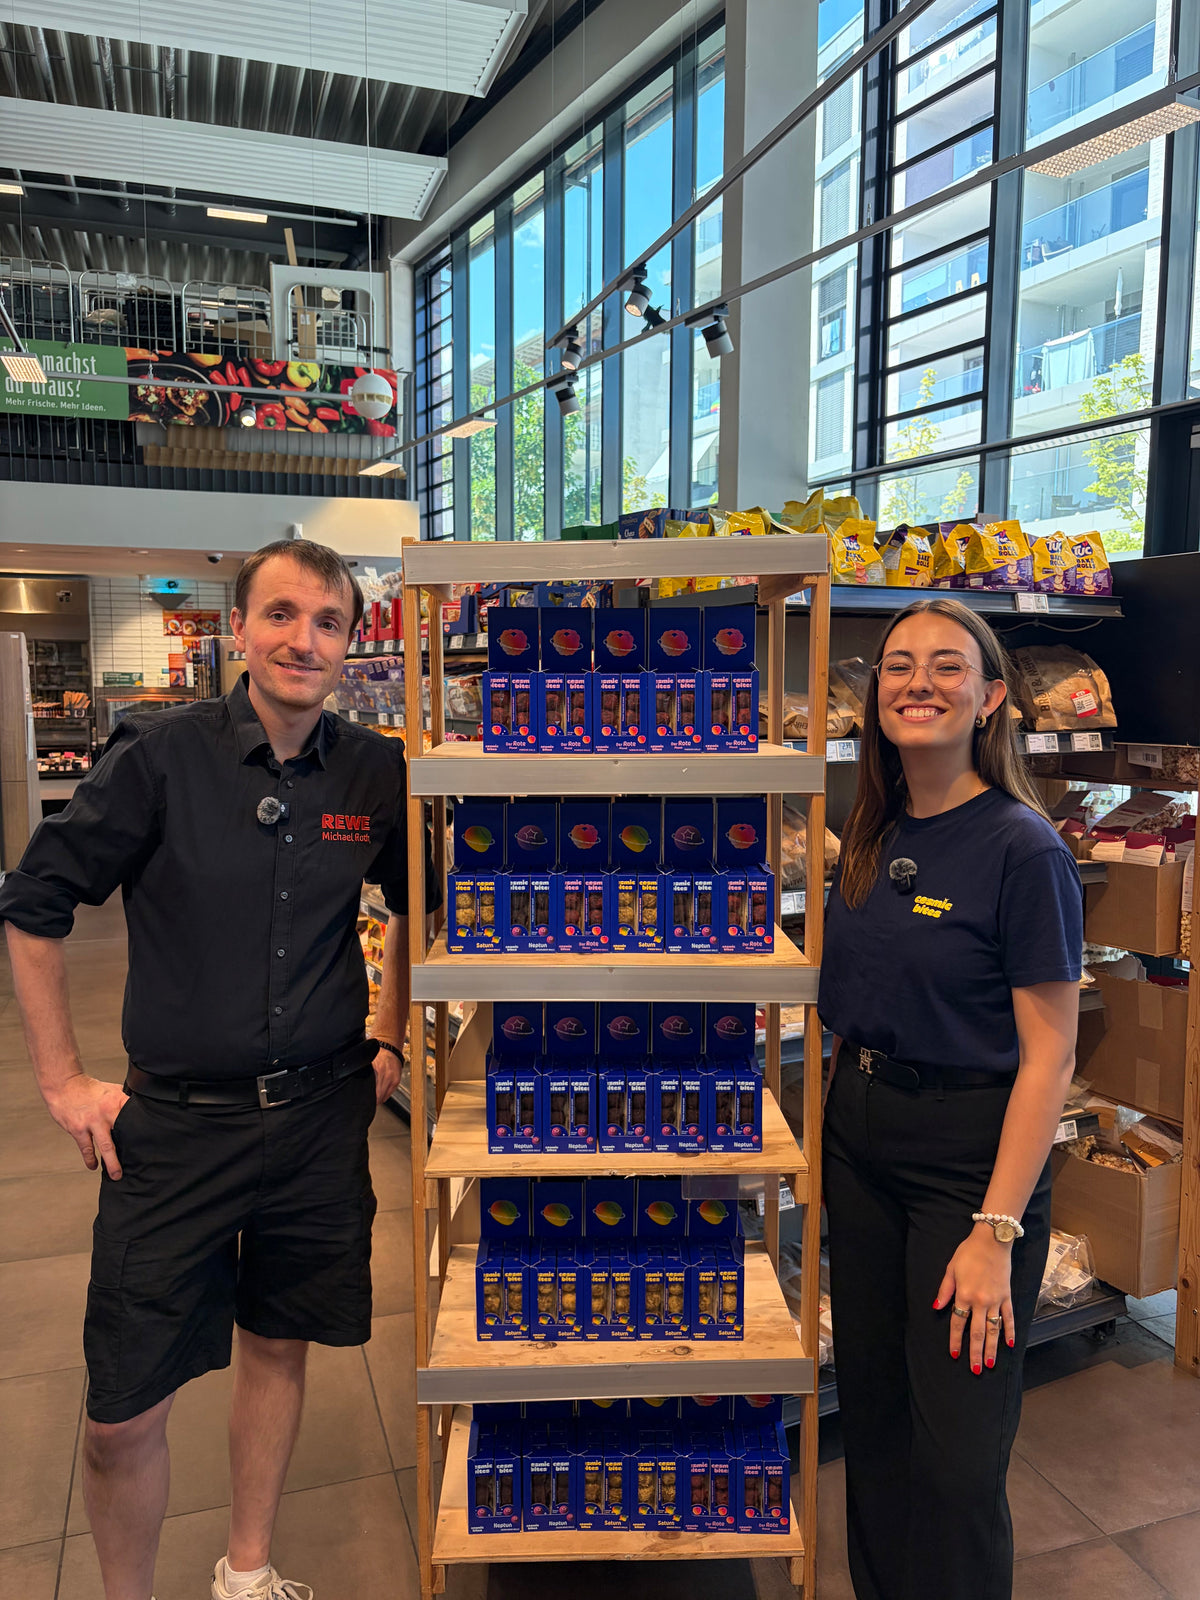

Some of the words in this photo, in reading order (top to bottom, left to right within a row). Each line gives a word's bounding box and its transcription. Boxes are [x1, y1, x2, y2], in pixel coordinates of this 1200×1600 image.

[42, 352, 97, 375] machst
[6, 398, 25, 406] Mehr
[28, 399, 58, 408] Frische.
[60, 402, 80, 410] Mehr
[82, 403, 106, 412] Ideen.
[1073, 544, 1092, 556] TUC
[322, 814, 370, 831] REWE
[322, 832, 354, 842] Michael
[914, 896, 953, 911] cosmic
[912, 904, 942, 918] bites
